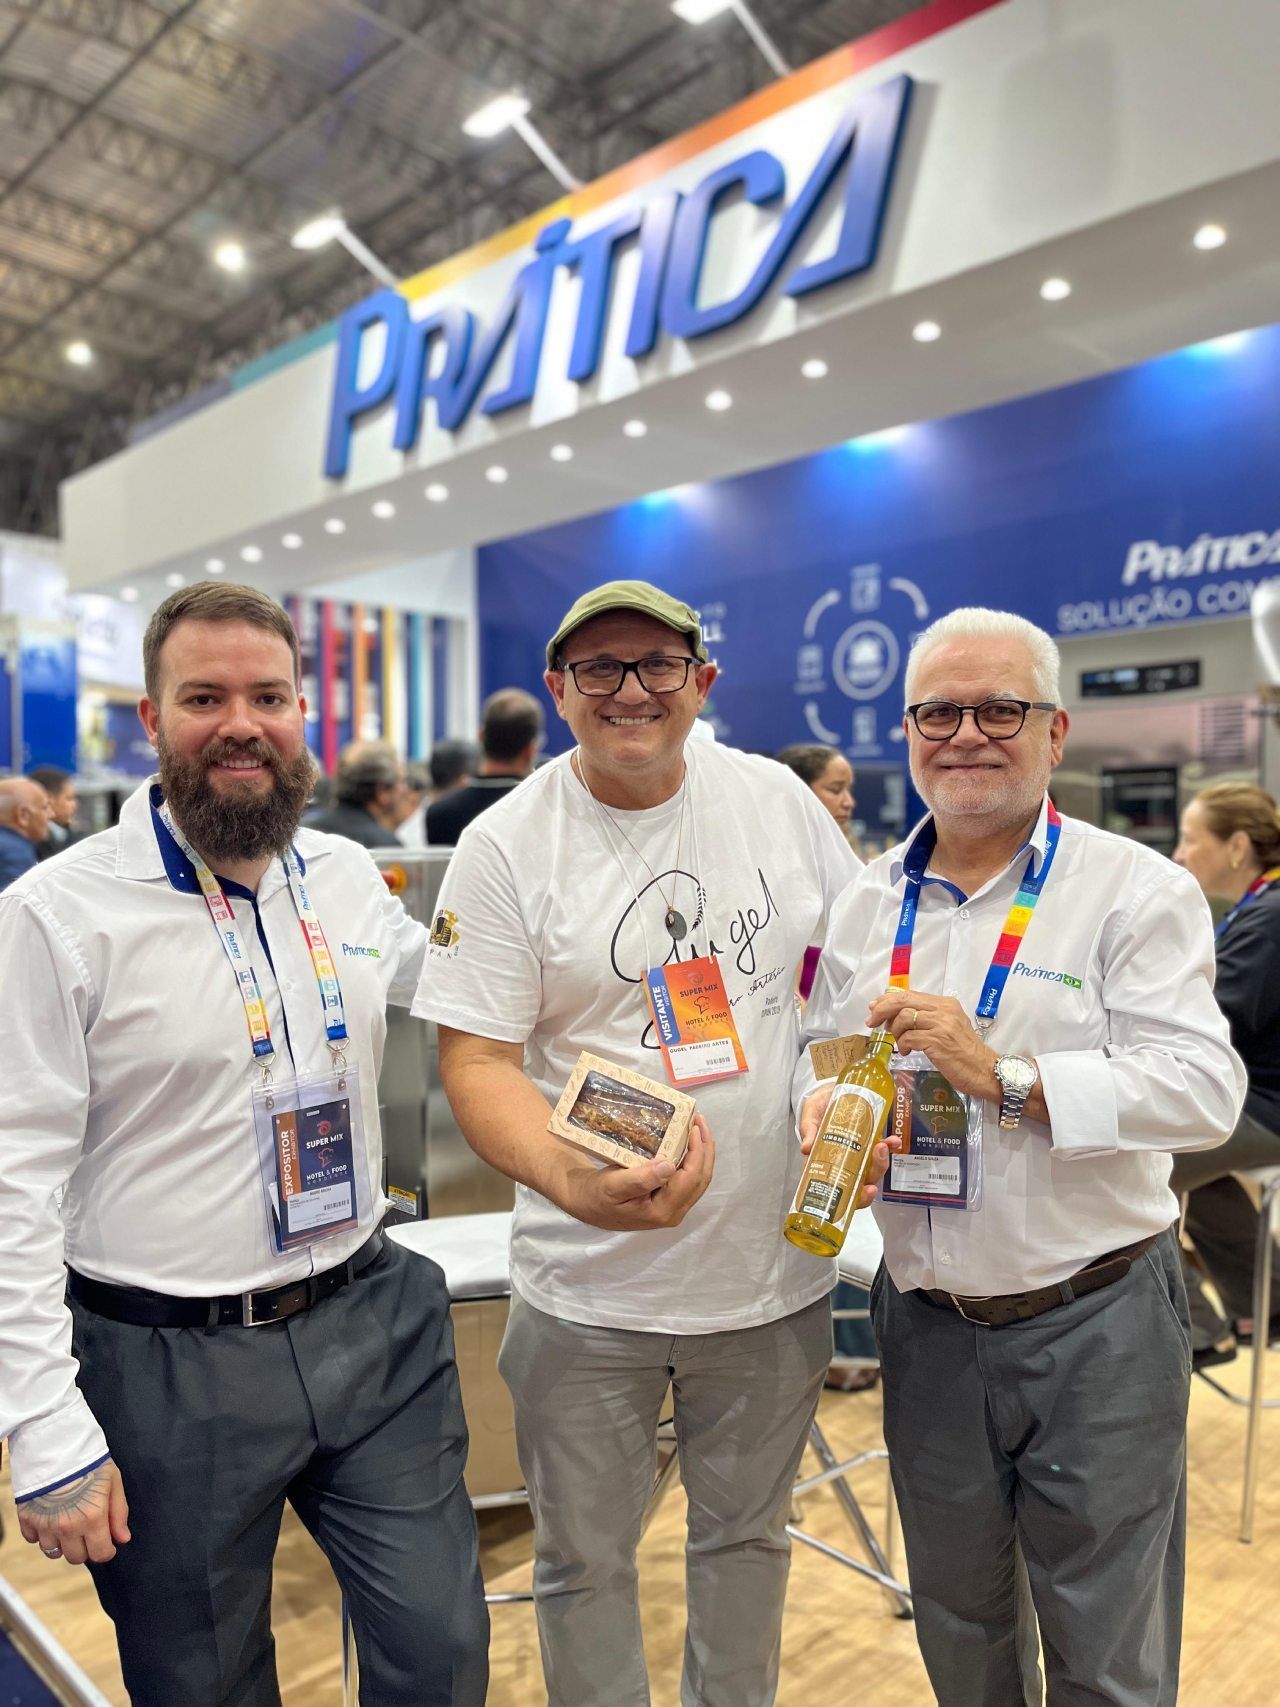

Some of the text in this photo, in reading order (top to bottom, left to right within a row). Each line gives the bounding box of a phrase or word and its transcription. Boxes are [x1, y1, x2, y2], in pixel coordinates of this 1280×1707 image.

[324, 72, 914, 481] PRÁTICA
[1056, 586, 1193, 633] SOLUÇÃO
[1013, 962, 1064, 982] PRÁTICA
[679, 983, 720, 998] SUPER MIX
[652, 985, 674, 1041] VISITANTE
[685, 1017, 704, 1026] HOTEL
[711, 1011, 728, 1021] FOOD
[919, 1104, 961, 1113] SUPER MIX
[895, 1086, 906, 1150] POSITOR
[306, 1133, 344, 1150] SUPER MIX
[823, 1134, 861, 1151] LIMONCELLO
[917, 1136, 937, 1144] HOTEL
[943, 1138, 961, 1146] FOOD
[281, 1130, 294, 1196] EXPOSITOR
[306, 1171, 325, 1181] HOTEL
[331, 1164, 347, 1174] FOOD
